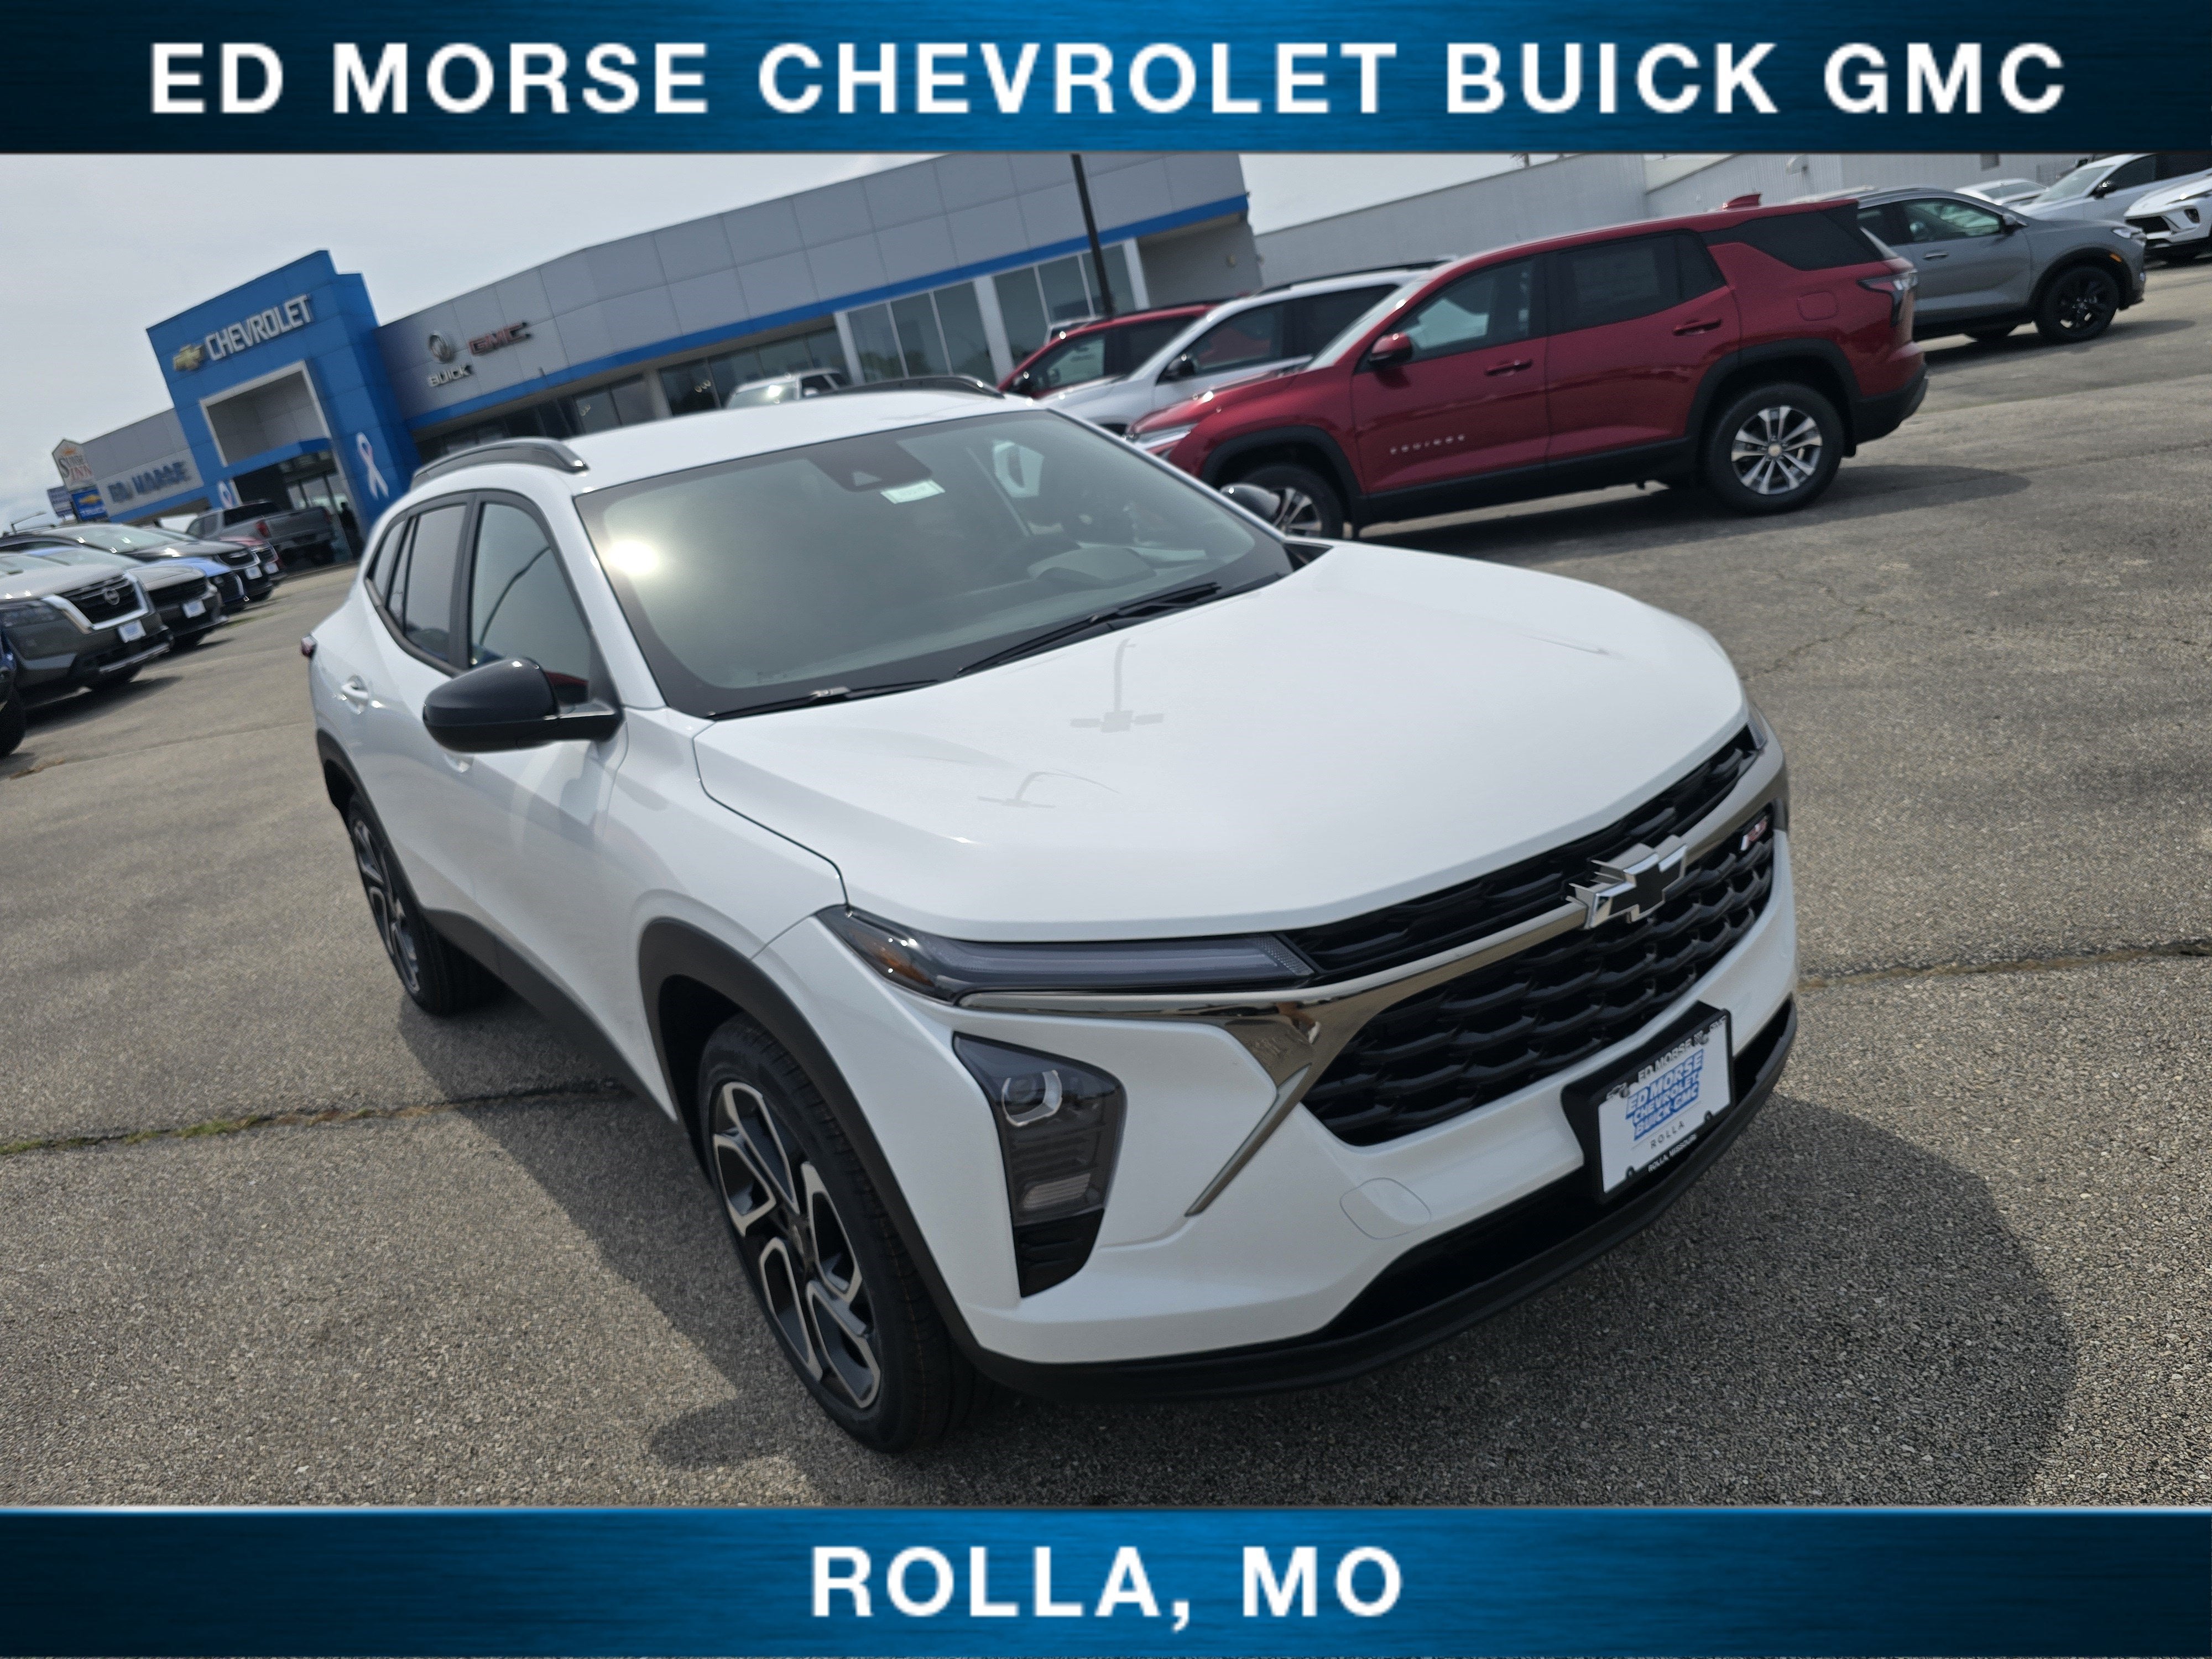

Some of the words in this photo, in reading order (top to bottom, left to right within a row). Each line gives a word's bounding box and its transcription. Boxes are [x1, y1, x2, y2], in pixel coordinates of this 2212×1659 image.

[205, 294, 311, 361] CHEVROLET
[469, 322, 530, 355] GMC
[429, 366, 470, 387] BUICK
[1627, 1087, 1650, 1117] ED
[1650, 1051, 1703, 1100] MORSE
[1673, 1082, 1699, 1110] GMC
[1651, 1121, 1684, 1149] ROLLA
